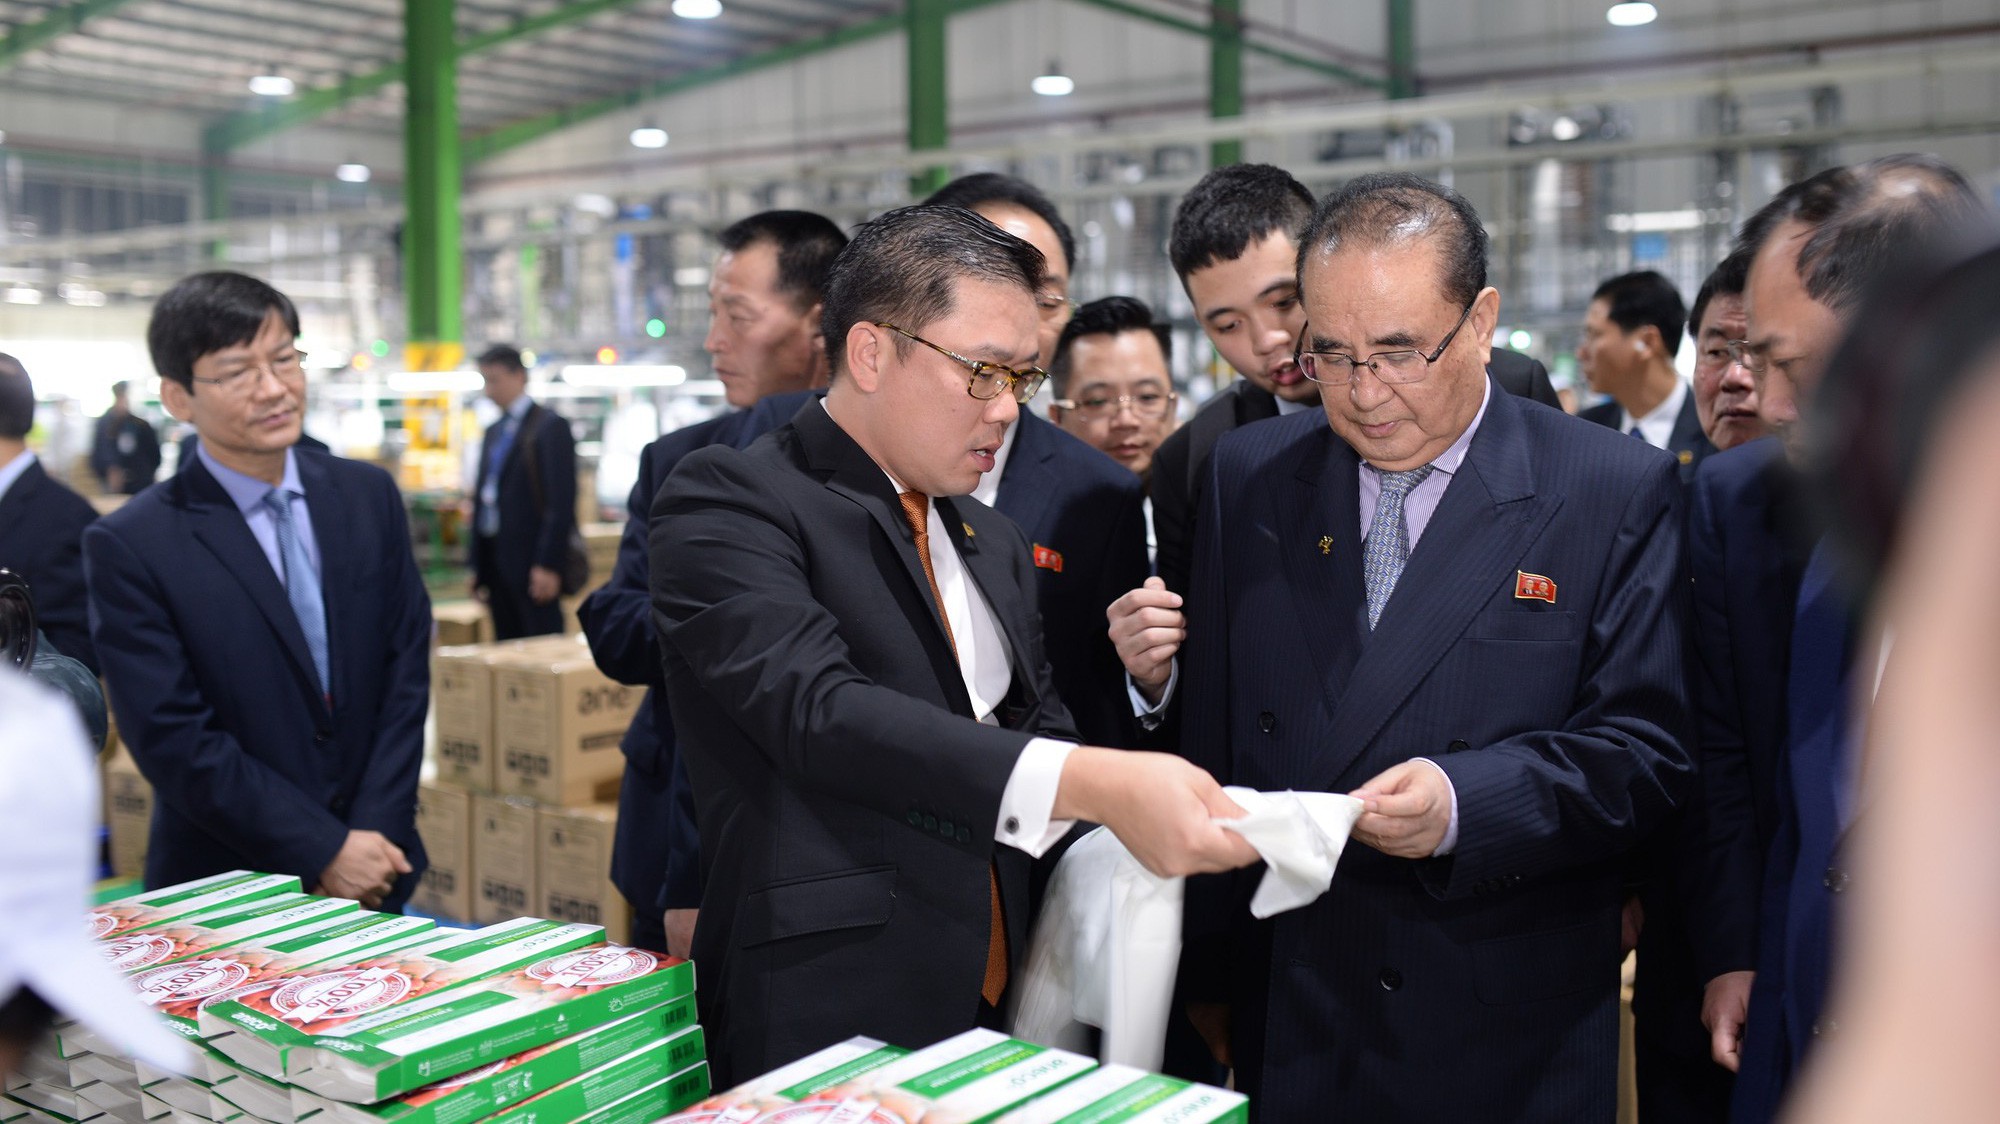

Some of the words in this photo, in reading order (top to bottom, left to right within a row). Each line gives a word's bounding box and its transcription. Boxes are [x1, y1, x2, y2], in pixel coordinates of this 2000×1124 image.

[359, 920, 409, 940] aneco
[524, 927, 579, 949] aneco
[561, 951, 620, 979] 100%
[149, 964, 217, 993] 100%
[306, 975, 378, 1008] 100%
[231, 1012, 272, 1031] aneco
